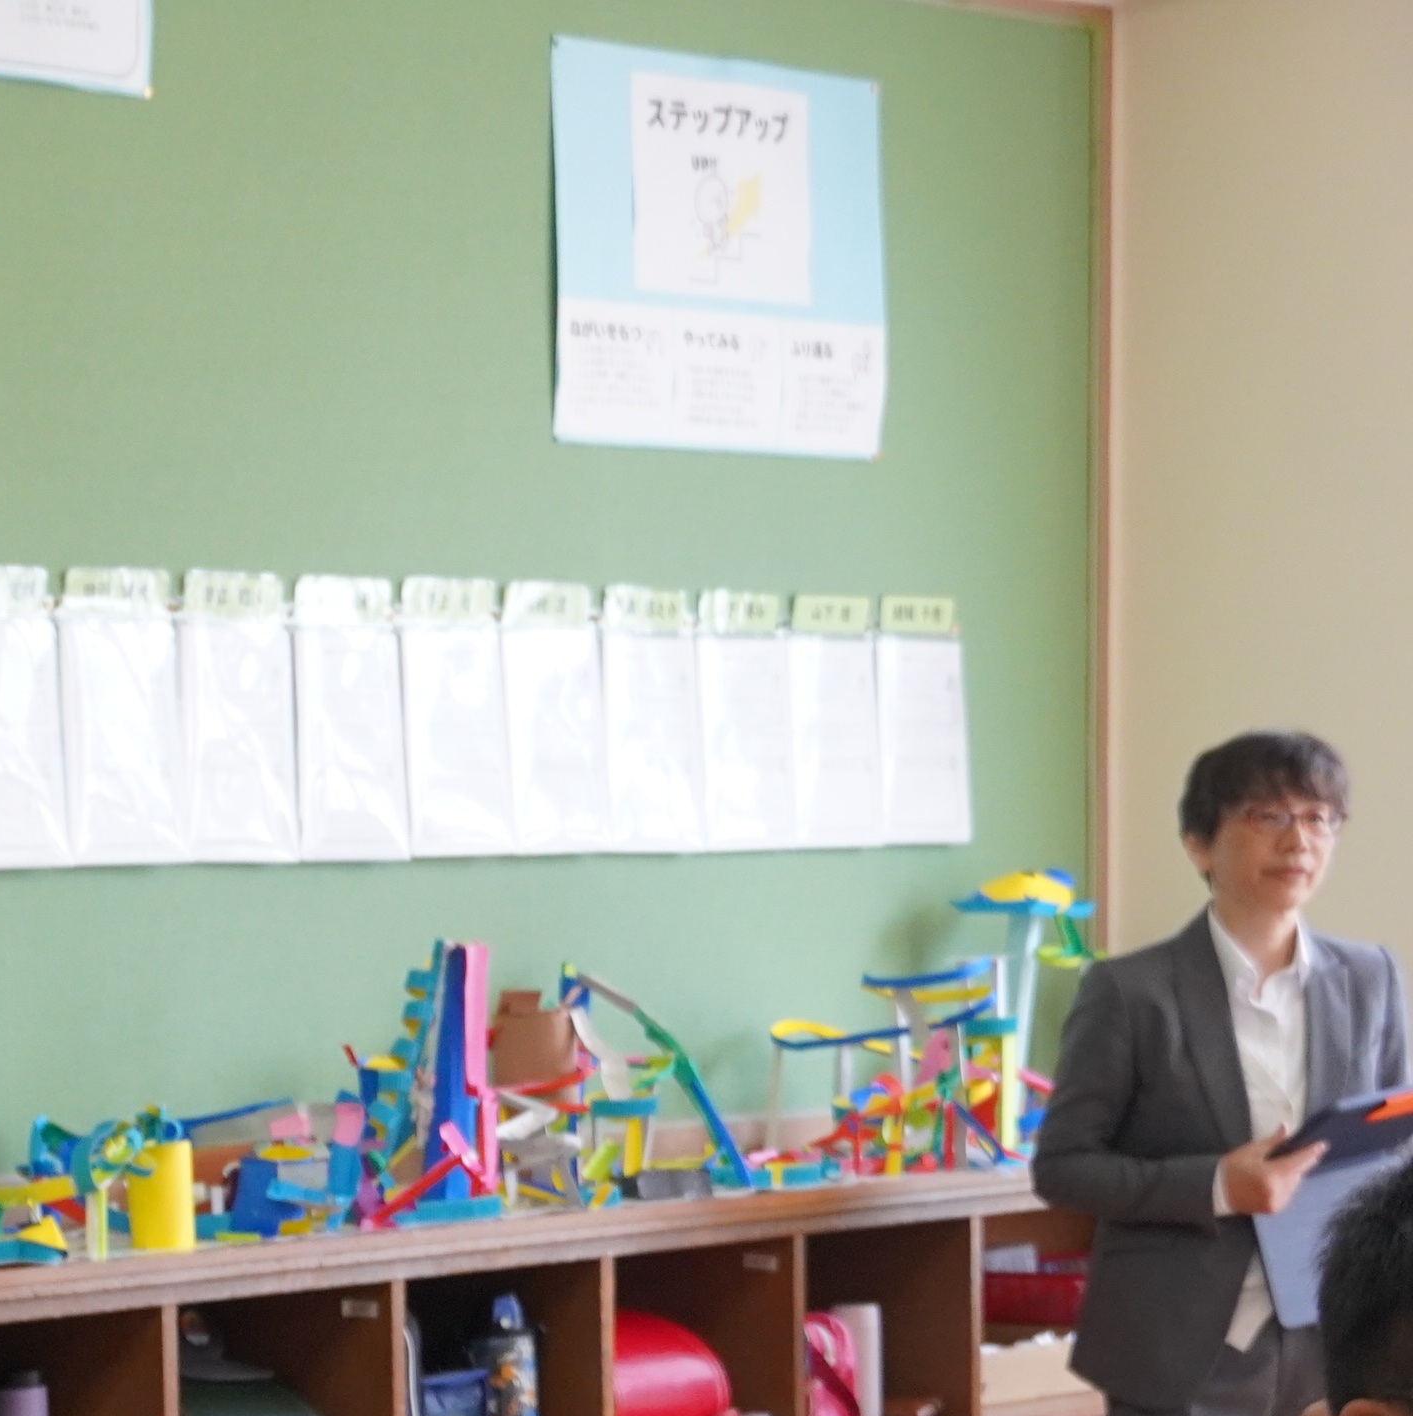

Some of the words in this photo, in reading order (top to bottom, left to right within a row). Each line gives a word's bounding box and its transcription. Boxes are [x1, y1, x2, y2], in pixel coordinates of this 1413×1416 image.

[647, 98, 789, 143] ステップアップ
